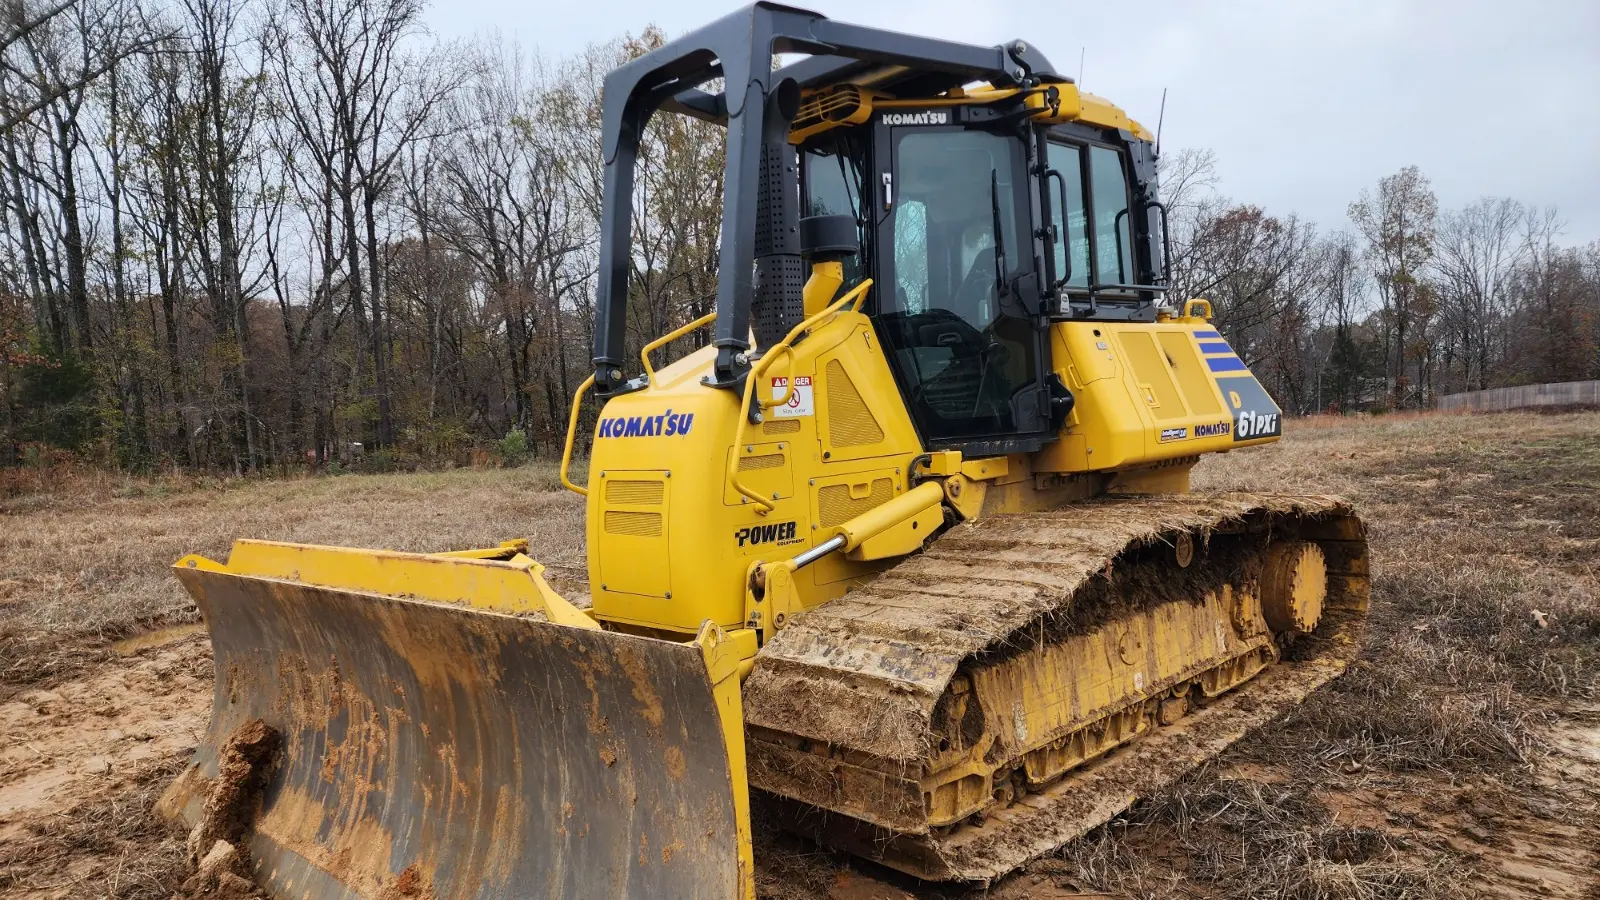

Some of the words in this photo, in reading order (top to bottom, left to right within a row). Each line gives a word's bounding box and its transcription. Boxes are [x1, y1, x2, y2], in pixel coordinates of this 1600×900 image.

[882, 110, 947, 125] KOMATSU
[782, 377, 810, 387] DGER
[1229, 391, 1241, 409] D
[599, 409, 694, 438] KOMATSU
[1195, 420, 1230, 437] KOMATSU
[735, 521, 796, 547] POWER
